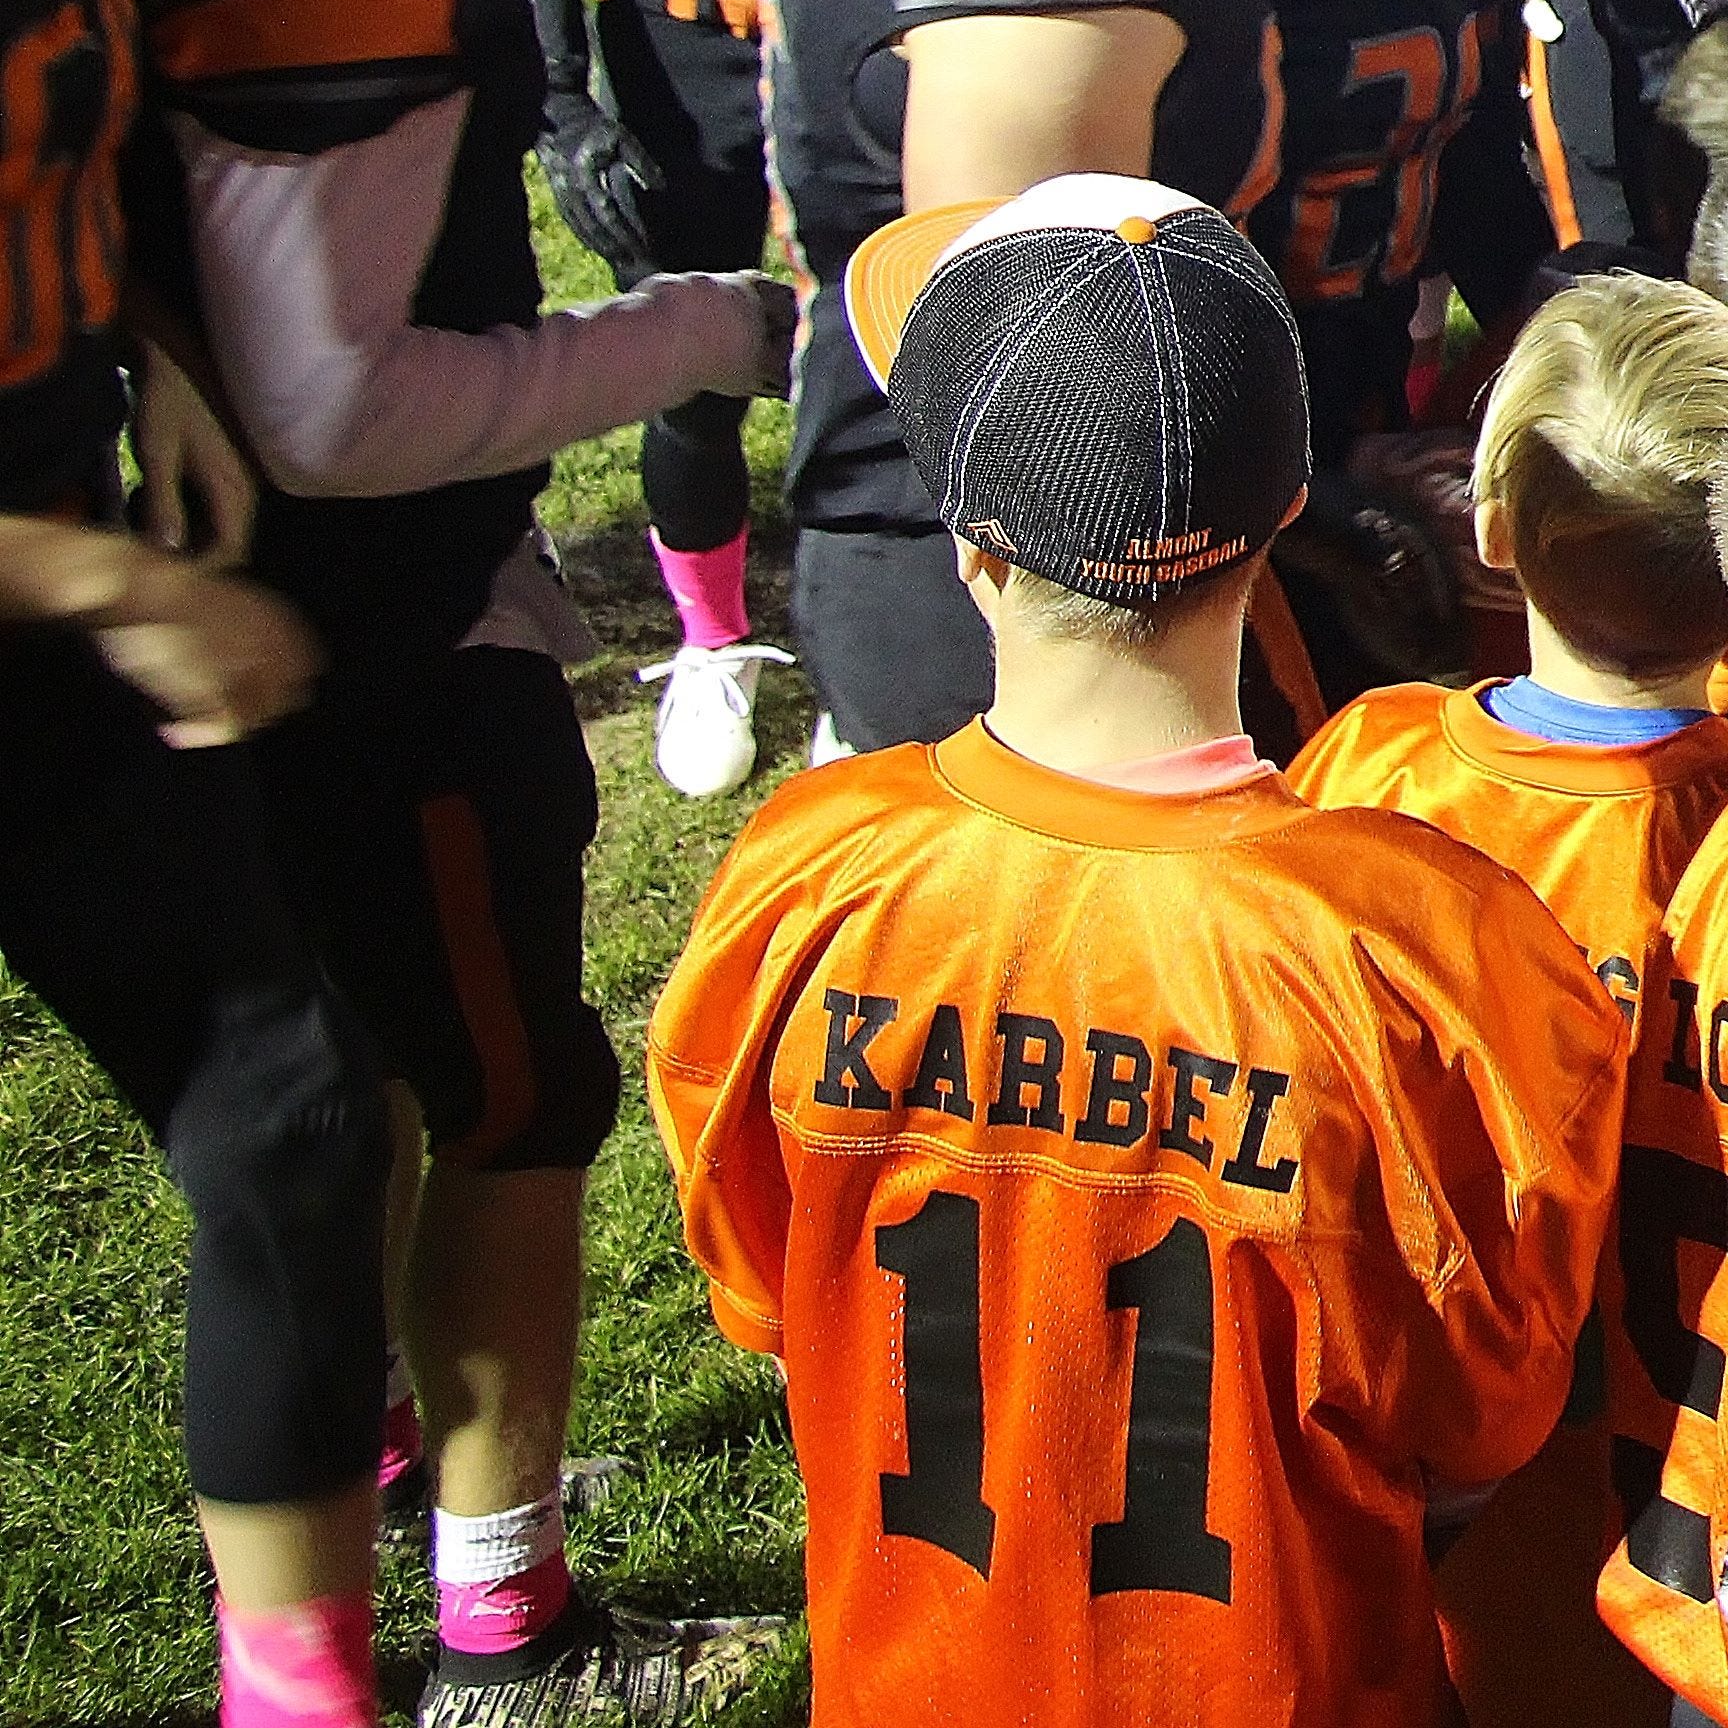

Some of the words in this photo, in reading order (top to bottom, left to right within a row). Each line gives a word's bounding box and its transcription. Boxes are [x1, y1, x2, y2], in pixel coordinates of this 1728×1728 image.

[1080, 558, 1151, 585] YOUTH
[1153, 535, 1249, 583] BASEBALL
[1126, 527, 1213, 560] ALMONT
[812, 986, 1300, 1194] KARBEL
[873, 1189, 1233, 1605] 11
